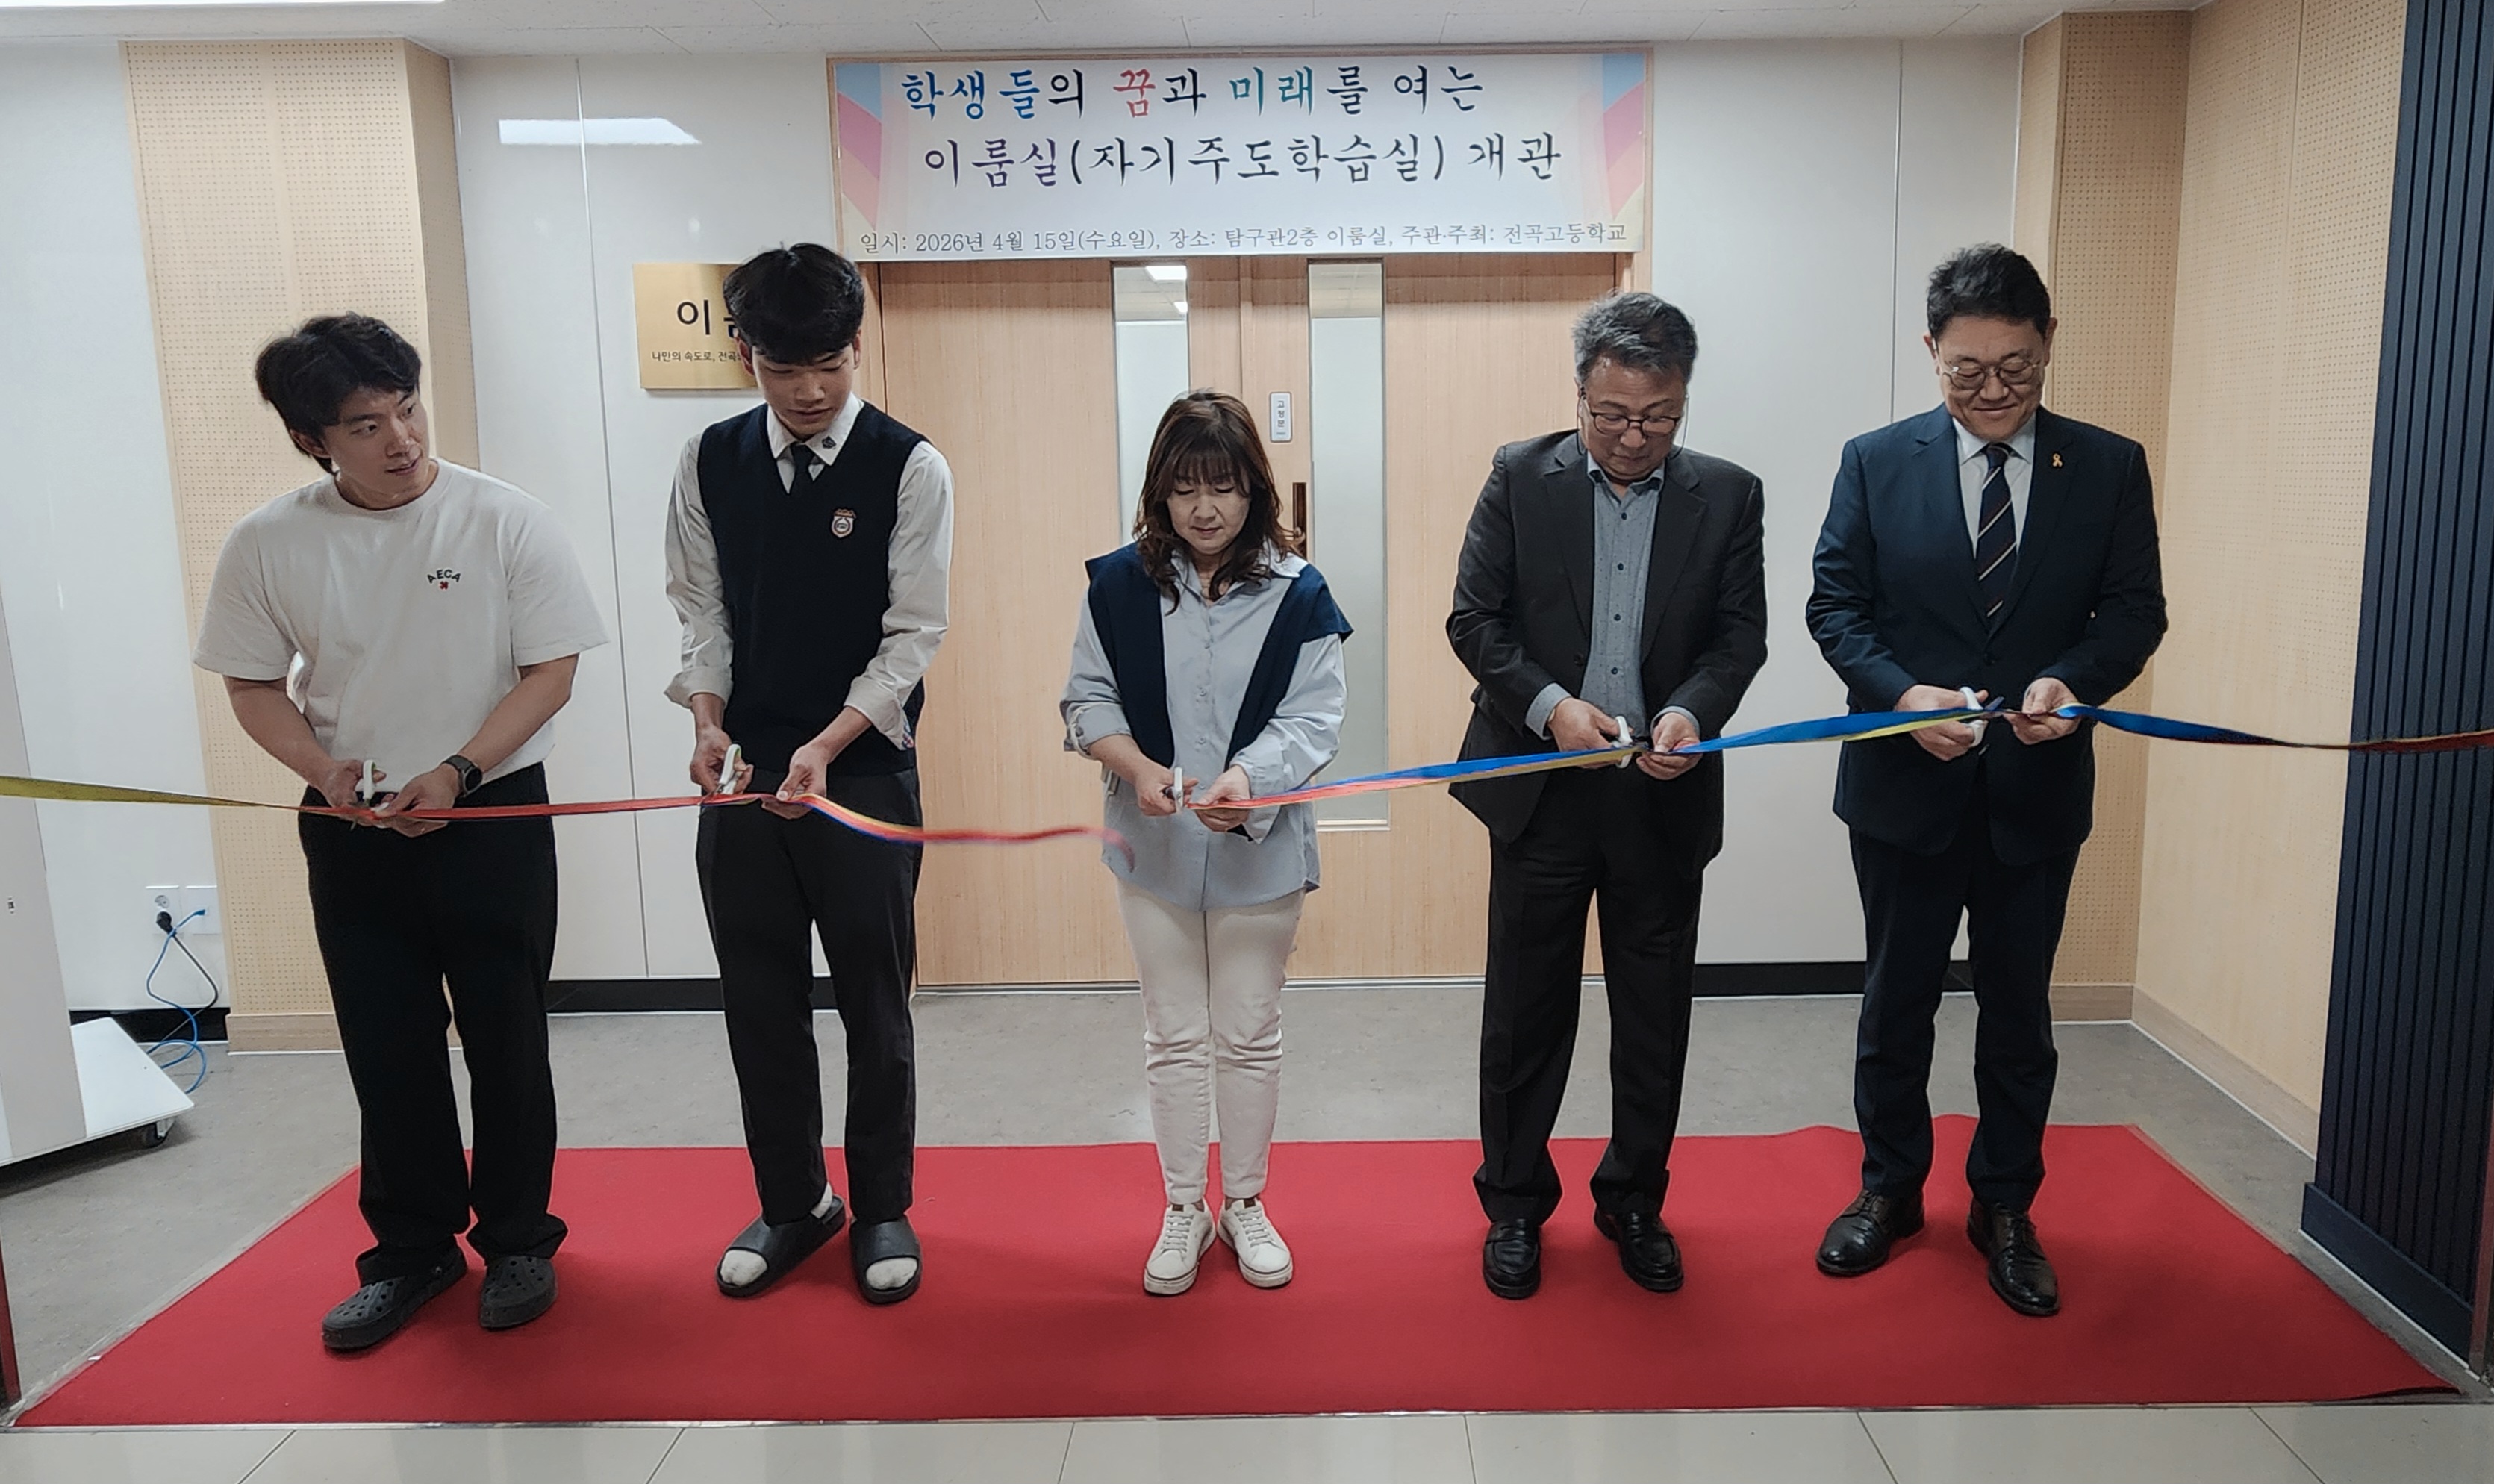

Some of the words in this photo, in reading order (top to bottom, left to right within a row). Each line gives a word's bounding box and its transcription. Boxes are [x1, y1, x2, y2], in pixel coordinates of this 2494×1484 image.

[900, 69, 1084, 120] 학생들의
[1113, 67, 1207, 118] 꿈과
[1229, 66, 1369, 116] 미래를
[1394, 64, 1483, 115] 여는
[925, 133, 1444, 188] 이룸실(자기주도학습실)
[1468, 131, 1562, 181] 개관
[861, 231, 907, 254] 일시:
[916, 232, 985, 252] 2026년
[992, 231, 1023, 252] 4월
[1034, 228, 1160, 252] 15일(수요일),
[1169, 228, 1215, 249] 장소:
[1225, 227, 1320, 248] 탐구관2층
[1327, 226, 1394, 247] 이룸실,
[1503, 222, 1627, 245] 전곡고등학교
[652, 351, 682, 363] 나만의
[685, 351, 716, 363] 속도로,
[717, 351, 742, 363] 전곡
[1277, 400, 1285, 428] 고정문
[427, 569, 461, 584] AECA
